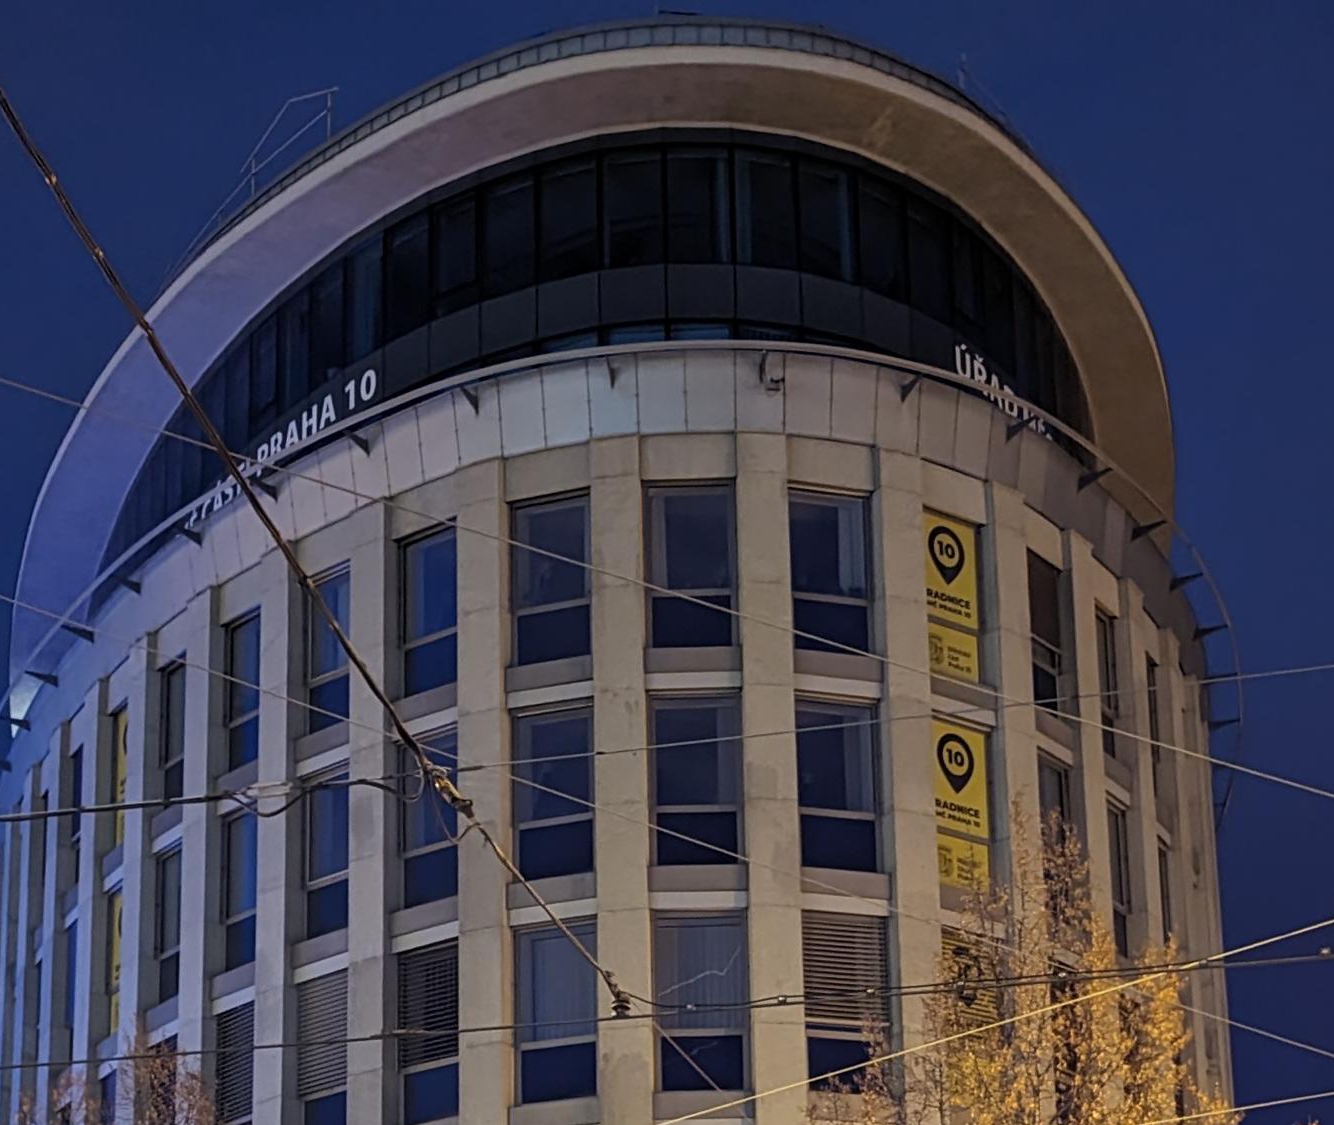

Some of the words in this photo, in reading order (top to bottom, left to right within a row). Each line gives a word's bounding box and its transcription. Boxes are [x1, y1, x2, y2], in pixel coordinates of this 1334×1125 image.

[955, 343, 1018, 418] ÚŘAD
[257, 394, 337, 477] PRAHA
[344, 369, 377, 410] 10
[936, 540, 956, 560] 10
[926, 587, 971, 610] RADNICE
[946, 748, 965, 768] 10
[934, 797, 980, 819] RADNICE
